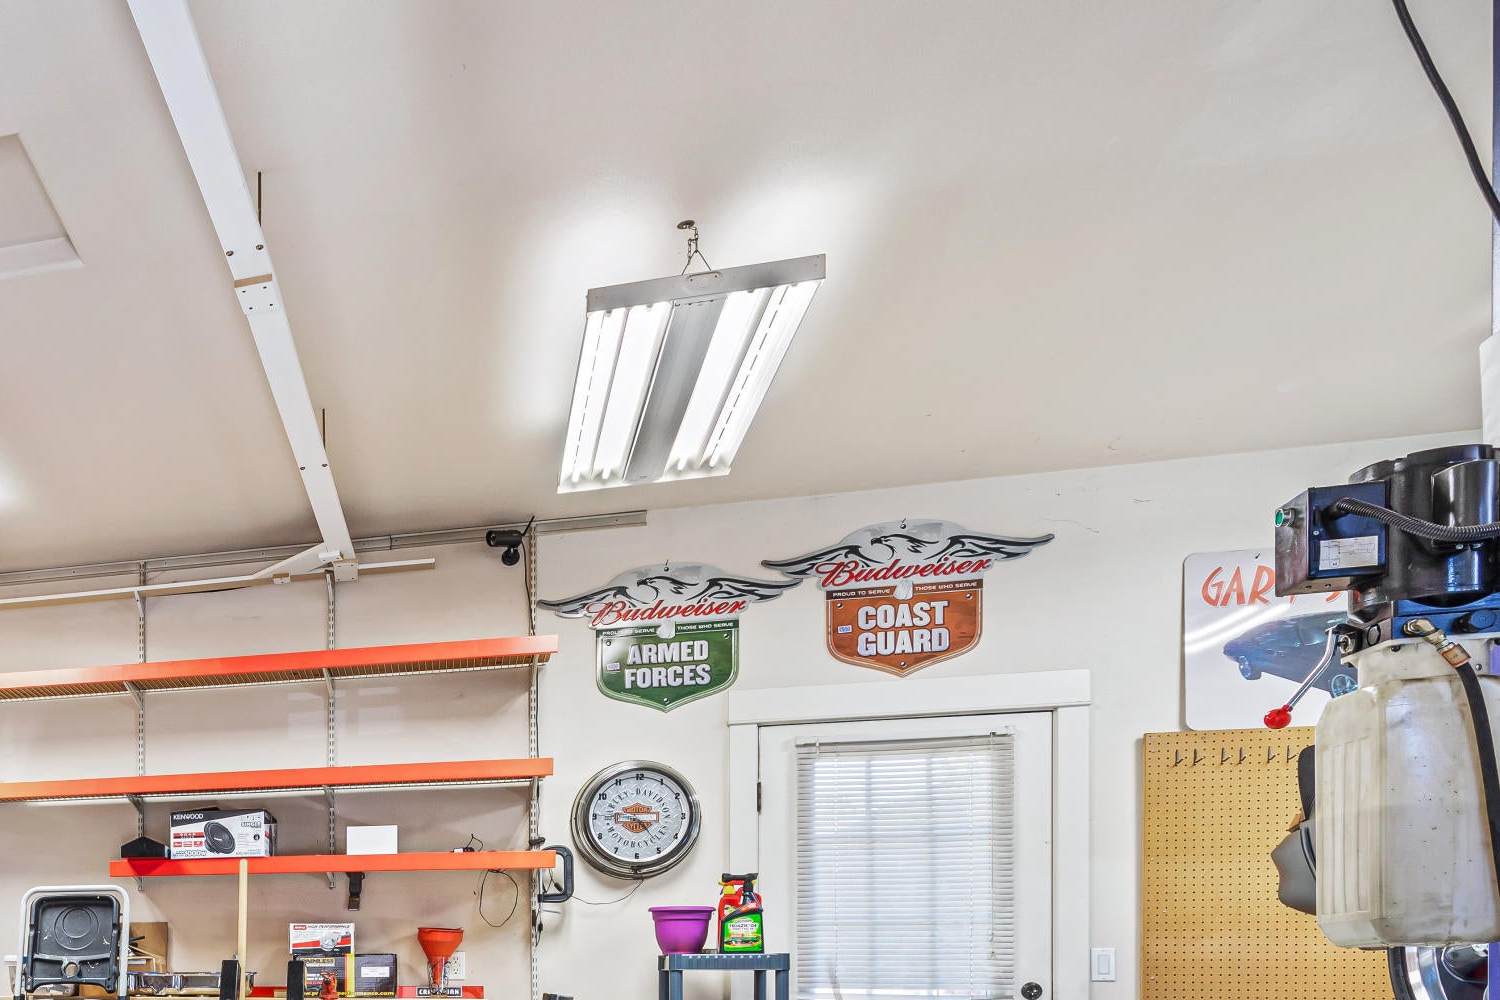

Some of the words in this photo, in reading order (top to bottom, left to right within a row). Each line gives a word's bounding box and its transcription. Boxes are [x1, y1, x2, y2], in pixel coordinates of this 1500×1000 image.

[815, 556, 992, 587] Budweiser
[585, 597, 747, 626] Budweiser
[857, 601, 949, 630] COAST
[627, 640, 709, 665] ARMED
[857, 627, 950, 657] GUARD
[624, 664, 711, 689] FORCES
